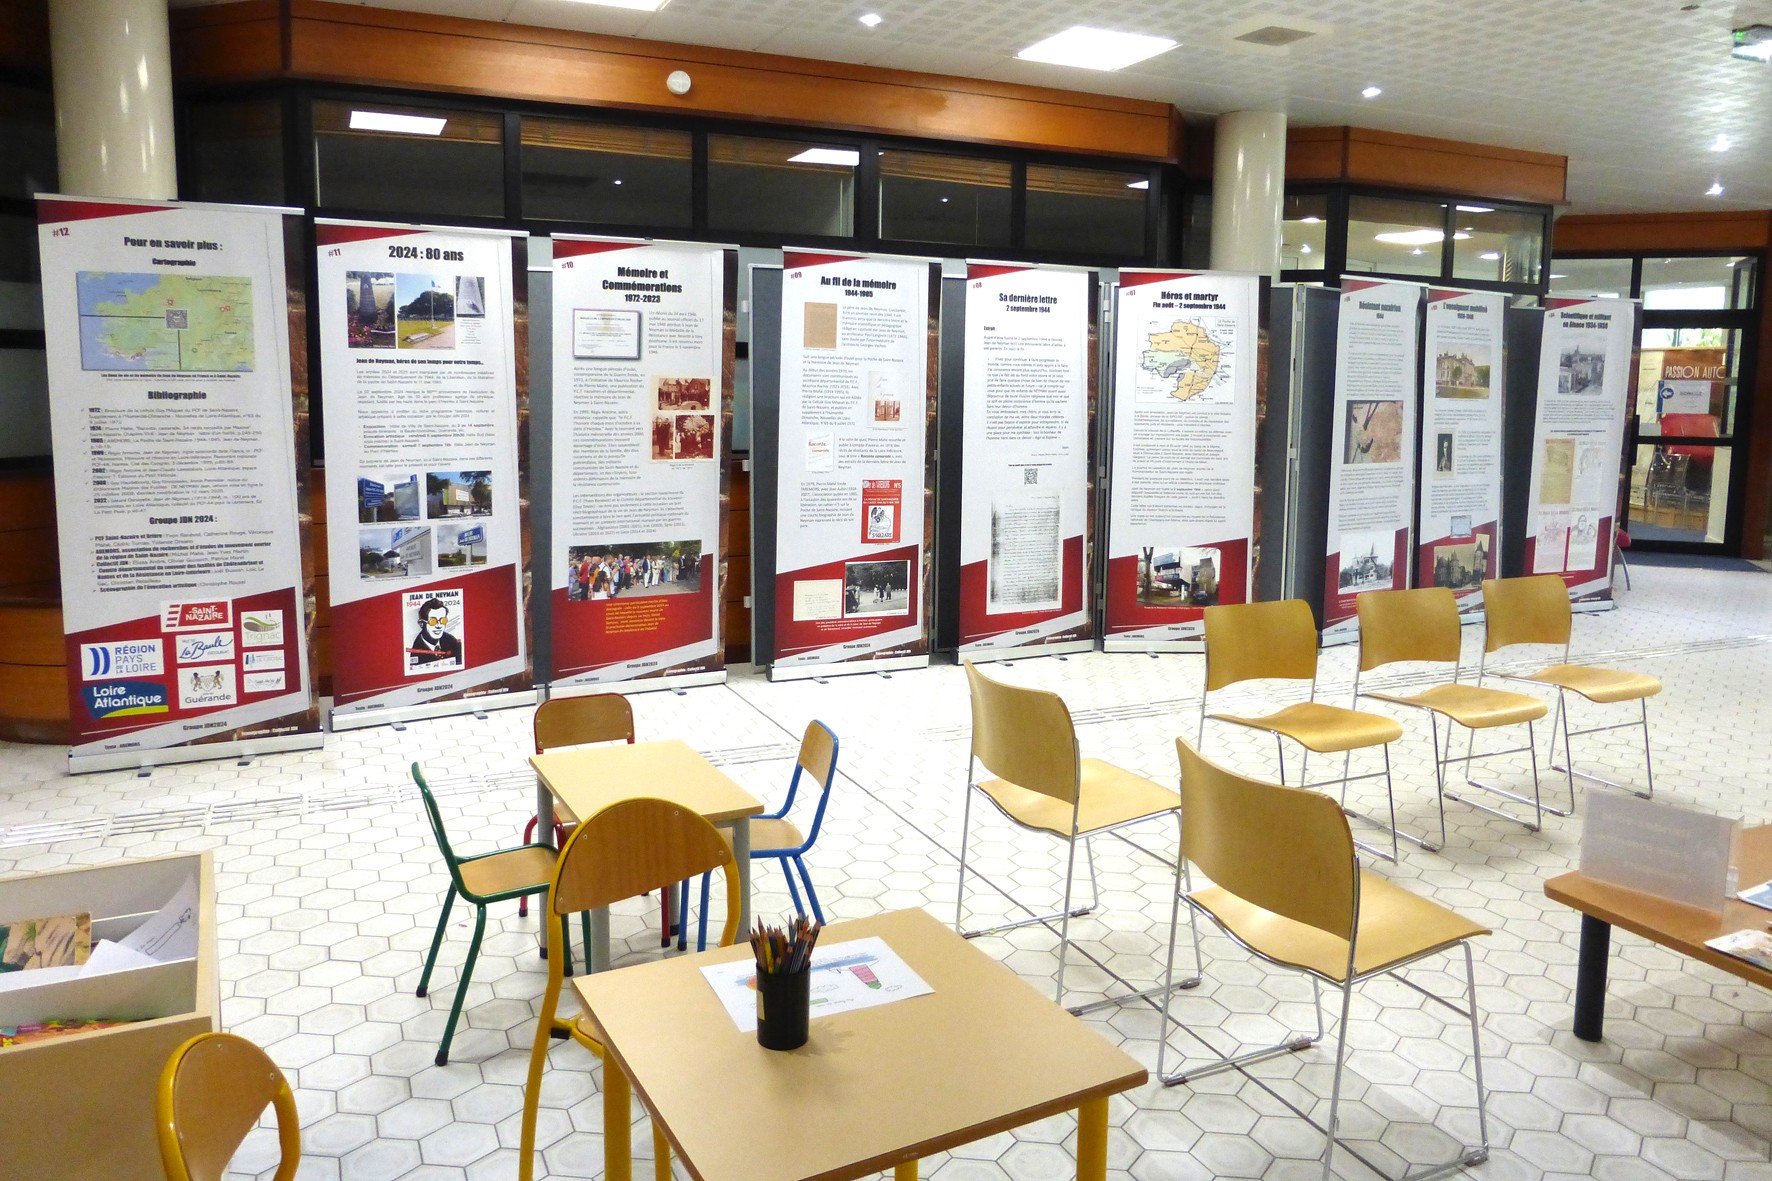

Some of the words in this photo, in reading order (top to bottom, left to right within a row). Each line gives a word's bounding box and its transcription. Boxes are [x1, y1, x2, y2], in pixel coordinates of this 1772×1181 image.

[124, 236, 147, 248] Pour
[149, 239, 163, 249] en
[164, 239, 195, 250] savoir
[197, 240, 217, 251] plus
[328, 248, 342, 257] #11
[388, 246, 418, 259] 2024
[426, 248, 441, 260] 80
[442, 250, 464, 262] ans
[152, 258, 196, 267] Cartographie
[617, 266, 658, 279] Mémoire
[660, 268, 669, 279] et
[602, 279, 682, 293] Commémorations
[820, 276, 831, 286] Au
[832, 277, 840, 286] fil
[842, 277, 852, 287] de
[853, 278, 861, 288] la
[862, 279, 897, 290] mémoire
[624, 294, 660, 303] 1972-2023
[999, 293, 1008, 302] Sa
[1009, 293, 1038, 304] dernière
[1039, 295, 1058, 304] lettre
[1161, 291, 1183, 301] Héros
[1184, 292, 1192, 301] et
[1193, 293, 1219, 302] martyr
[1665, 365, 1700, 378] PASSION
[148, 391, 206, 401] Bibliographie
[149, 516, 177, 525] Groupe
[194, 515, 213, 523] 2024
[186, 612, 223, 621] NAZAIRE
[245, 631, 281, 642] Trignac
[115, 644, 156, 655] RÉGION
[116, 654, 143, 665] PAYS
[126, 663, 157, 673] LOIRE
[93, 685, 127, 697] Loire
[94, 695, 162, 709] Atlantique
[184, 693, 232, 704] Guérande
